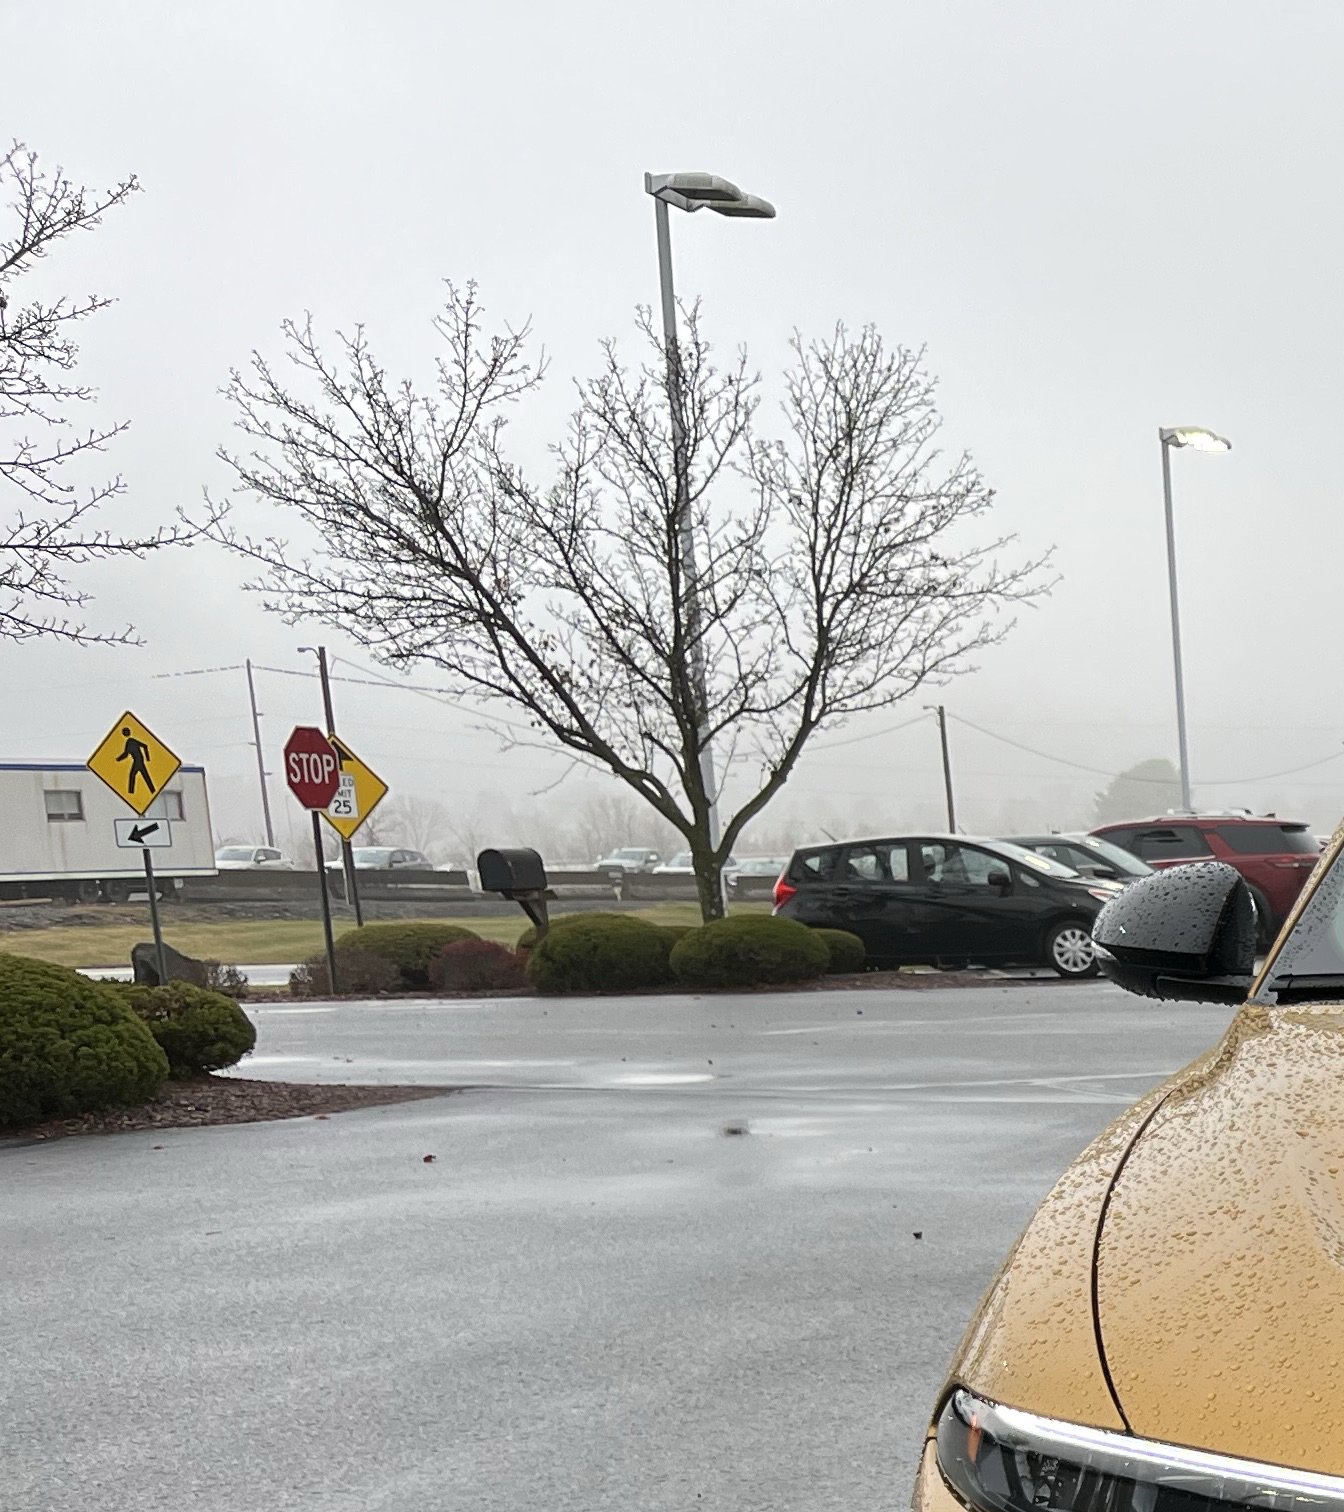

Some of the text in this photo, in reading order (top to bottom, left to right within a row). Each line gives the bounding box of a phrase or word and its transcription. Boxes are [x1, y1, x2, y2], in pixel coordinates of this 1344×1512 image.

[289, 752, 335, 784] STOP
[337, 789, 352, 798] MIT
[334, 799, 352, 814] 25
